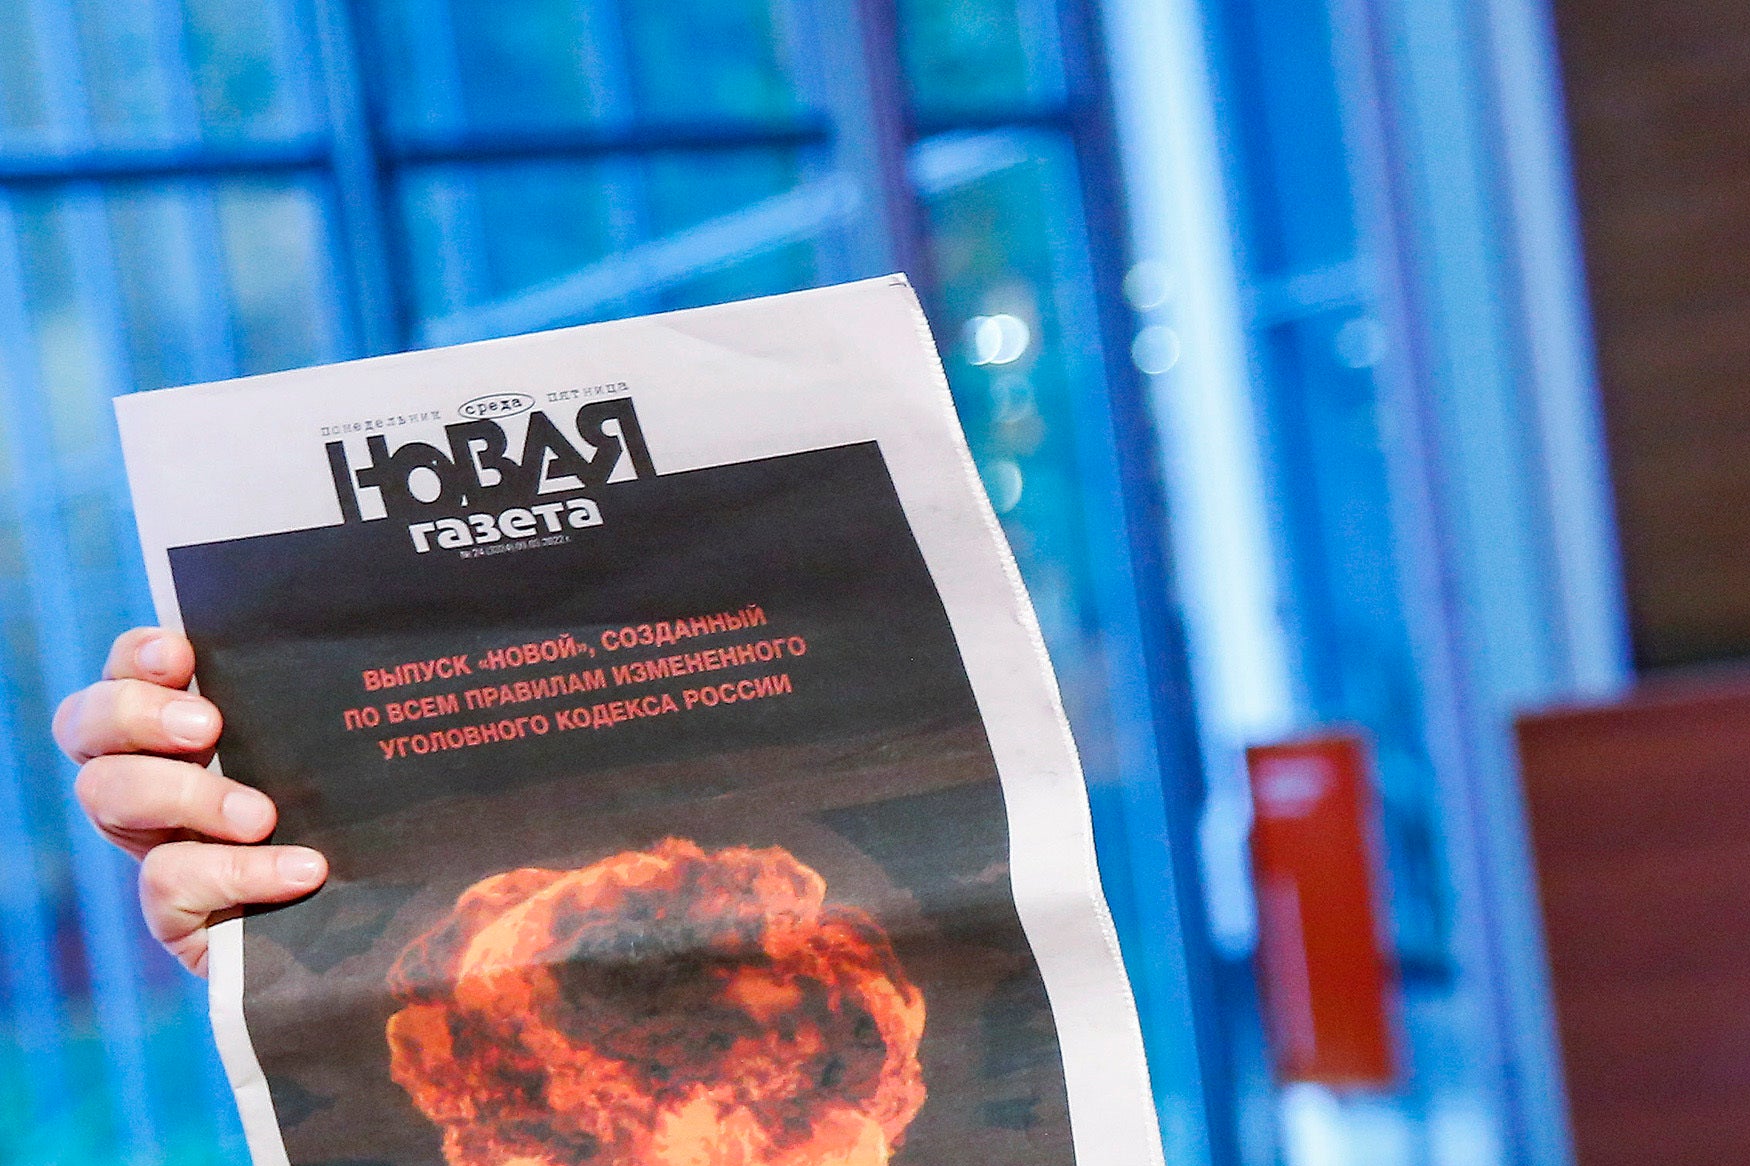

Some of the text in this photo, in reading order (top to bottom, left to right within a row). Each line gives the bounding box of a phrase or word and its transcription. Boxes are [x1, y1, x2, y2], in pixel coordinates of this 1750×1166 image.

[465, 397, 522, 415] среда
[546, 381, 629, 402] пятница
[408, 498, 604, 553] газета
[343, 636, 807, 731] ПО ВСЕМ ПРАВИЛАМ ИЗМЕНЕННОГО
[362, 603, 767, 691] ВЫПУСК «НОВОЙ», СОЗДАННЫЙ
[378, 673, 793, 760] УГОЛОВНОГО КОДЕКСА РОССИИ
